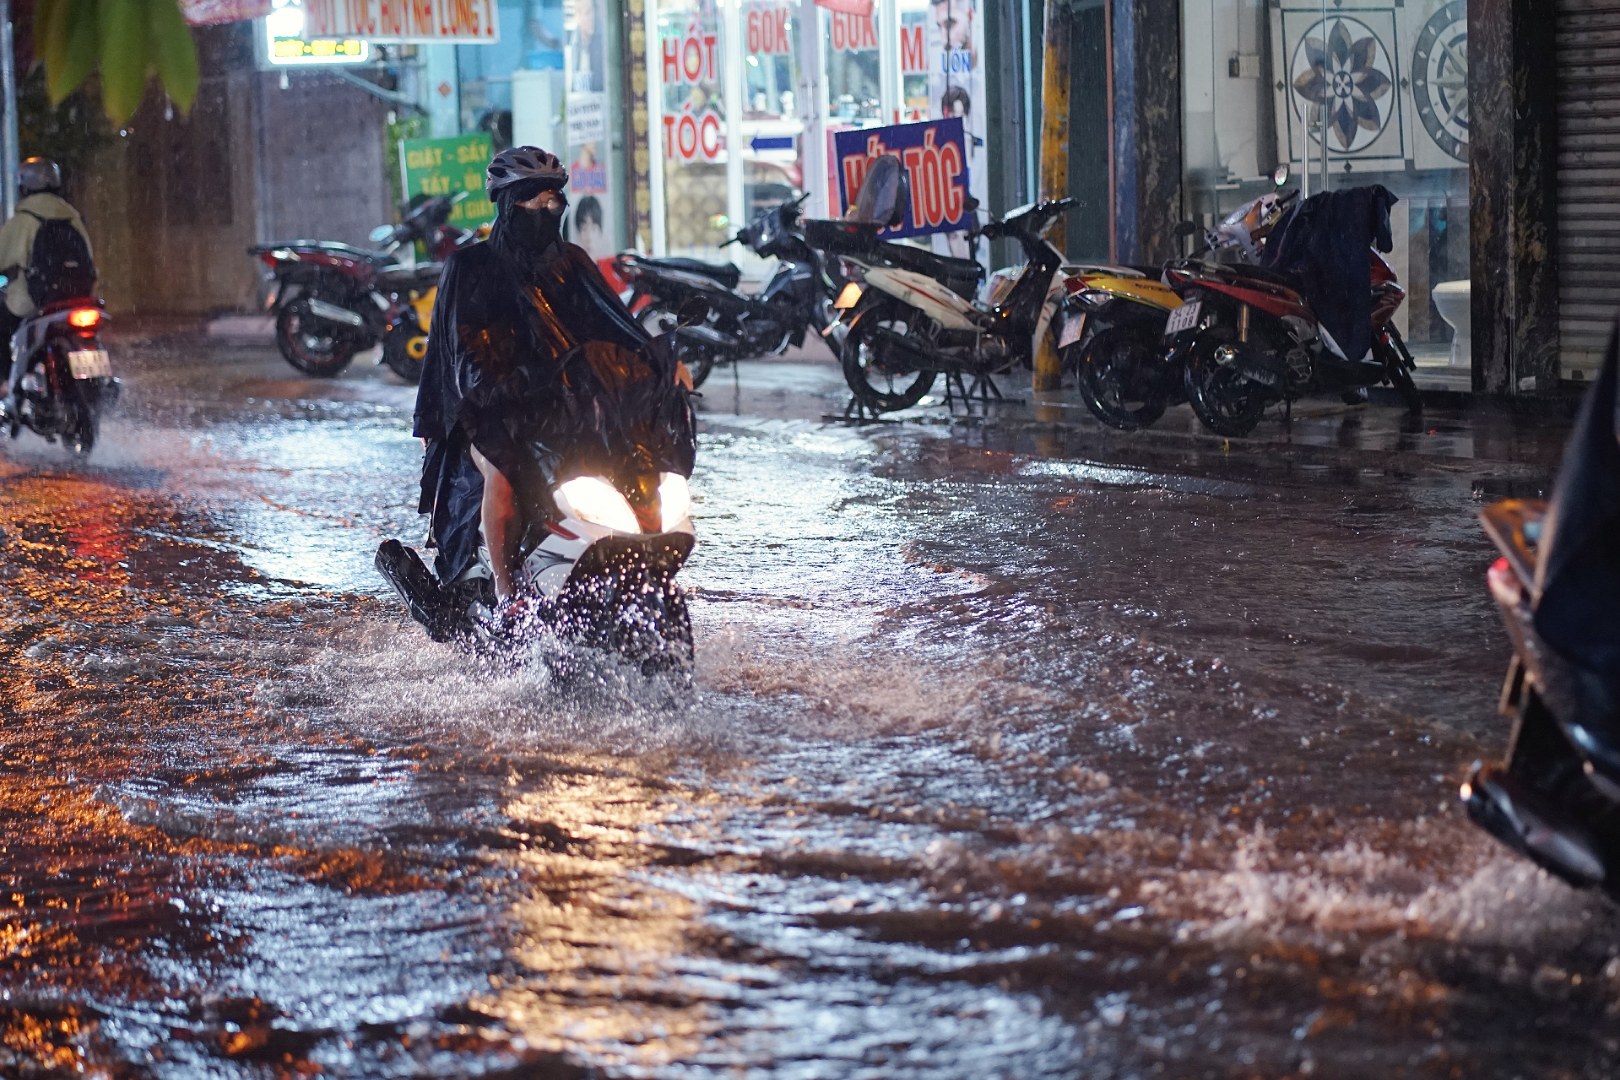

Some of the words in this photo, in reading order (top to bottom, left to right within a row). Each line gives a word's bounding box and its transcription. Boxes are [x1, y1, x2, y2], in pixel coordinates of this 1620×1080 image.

[747, 9, 790, 54] 60K
[663, 102, 720, 159] TÓC
[903, 127, 965, 229] TÓC
